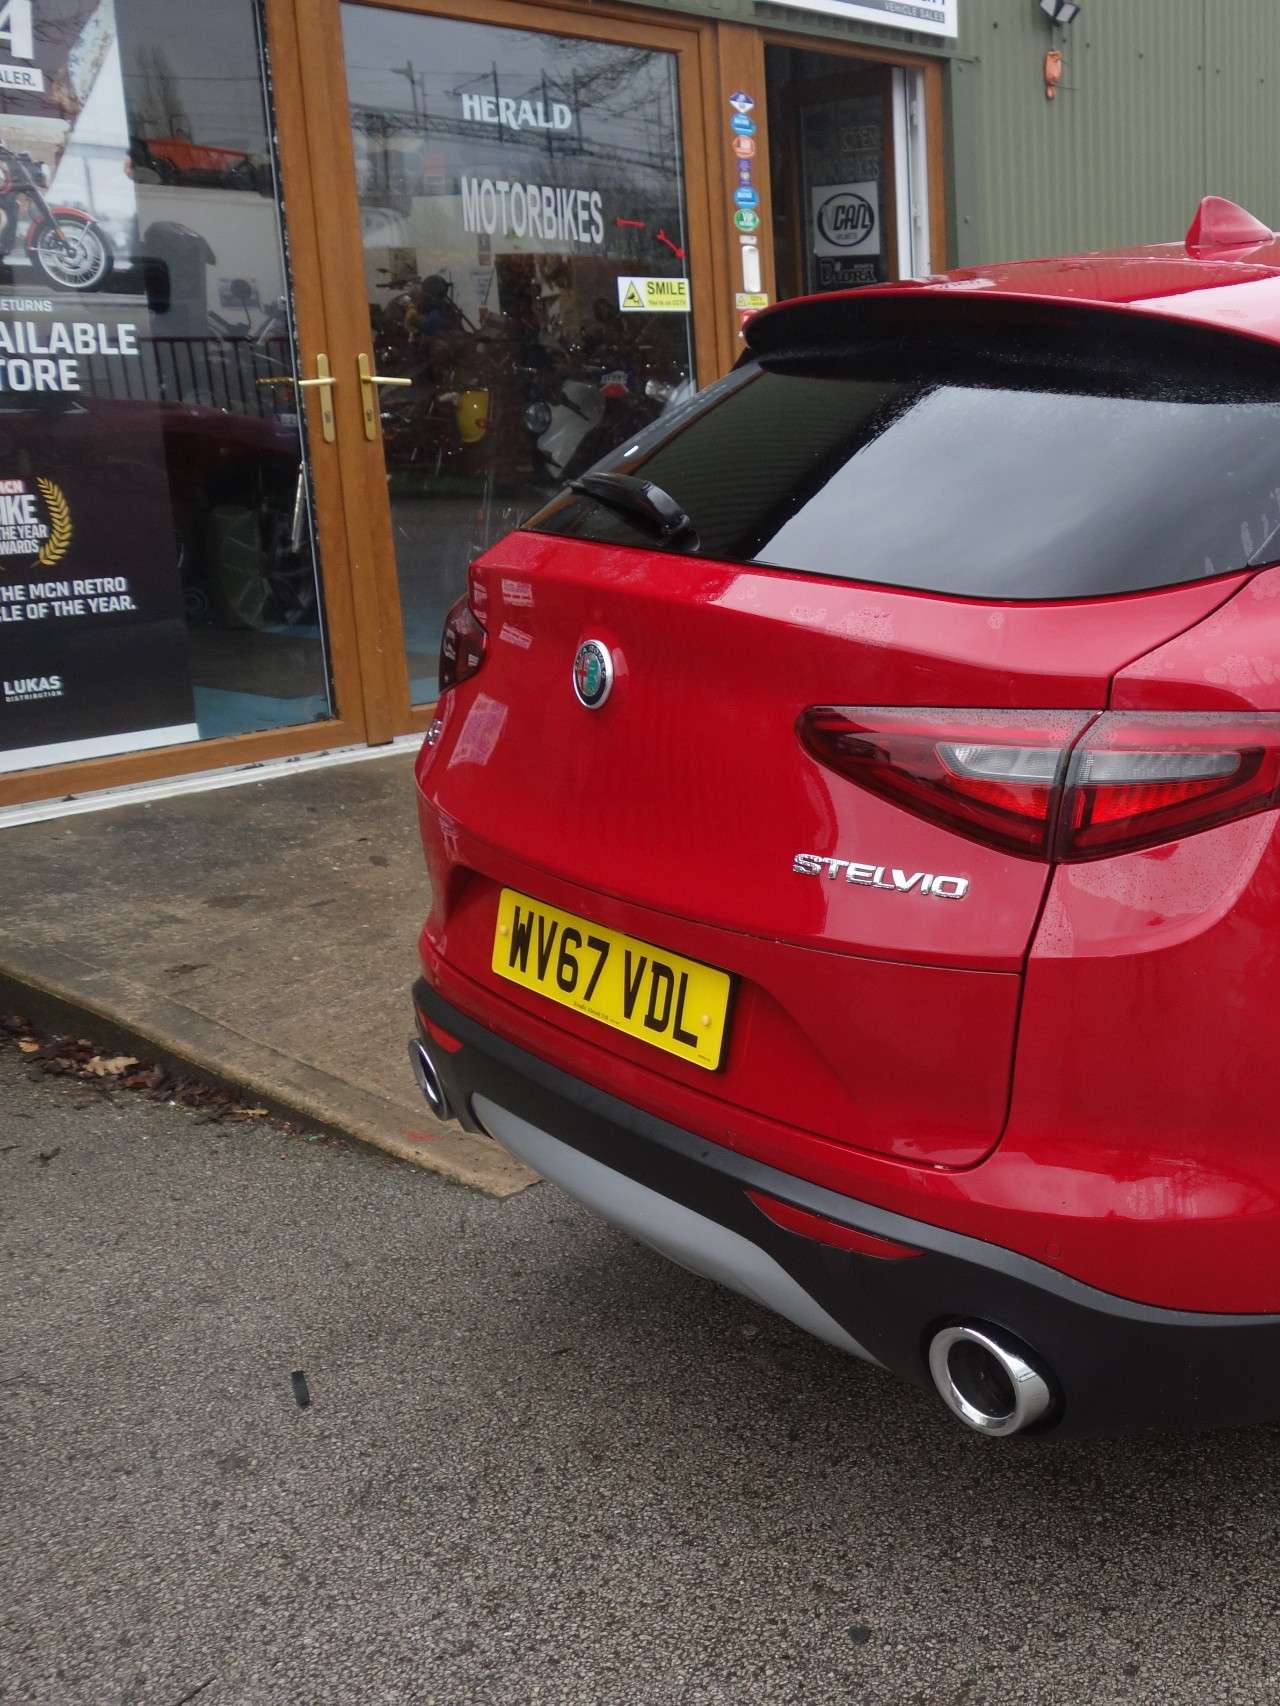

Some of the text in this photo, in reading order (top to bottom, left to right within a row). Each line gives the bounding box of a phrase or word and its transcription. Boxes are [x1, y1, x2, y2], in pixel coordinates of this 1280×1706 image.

[461, 93, 572, 130] HERALD
[461, 176, 604, 244] MOTORBIKES
[647, 281, 686, 295] SMILE
[17, 524, 49, 539] YEAR
[28, 582, 70, 600] MCN
[73, 577, 127, 596] RETRO
[0, 595, 137, 622] LE OF THE YEAR.
[3, 675, 63, 695] LUKAS
[793, 853, 969, 899] STELVIO
[508, 905, 698, 1048] WV67 VDL
